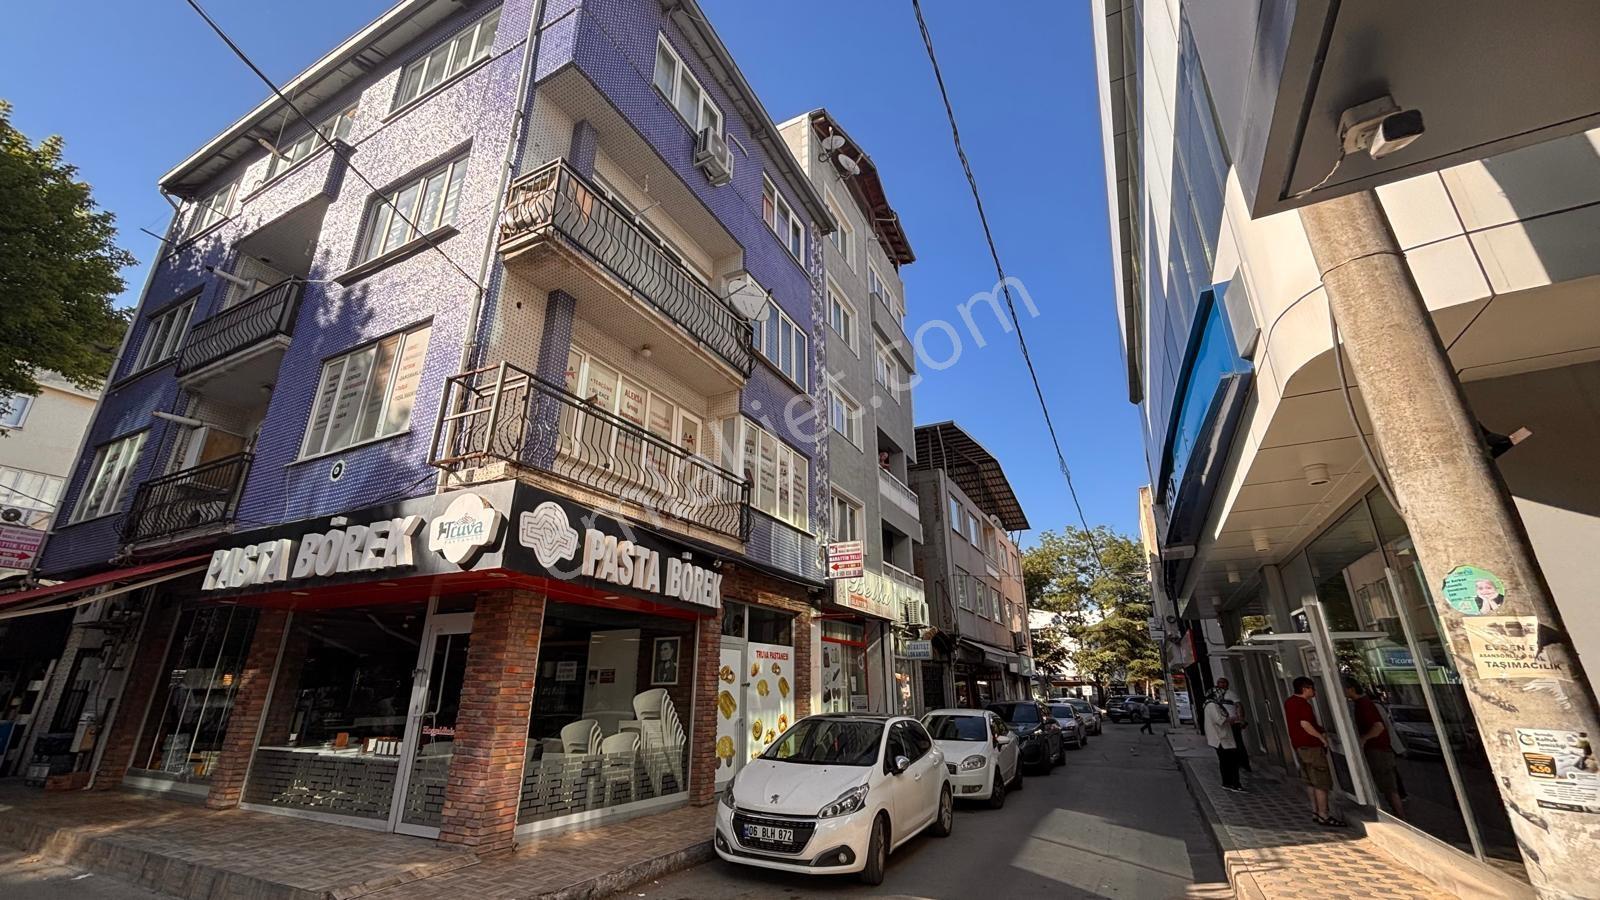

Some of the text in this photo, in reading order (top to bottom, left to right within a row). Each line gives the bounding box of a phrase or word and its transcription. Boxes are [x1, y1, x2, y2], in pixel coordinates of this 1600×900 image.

[202, 513, 425, 591] PASTA BÖREK
[444, 520, 484, 539] Truva
[582, 527, 724, 609] PASTA BÖREK
[749, 825, 758, 836] 06
[762, 827, 776, 838] BLH
[778, 830, 792, 841] 872
